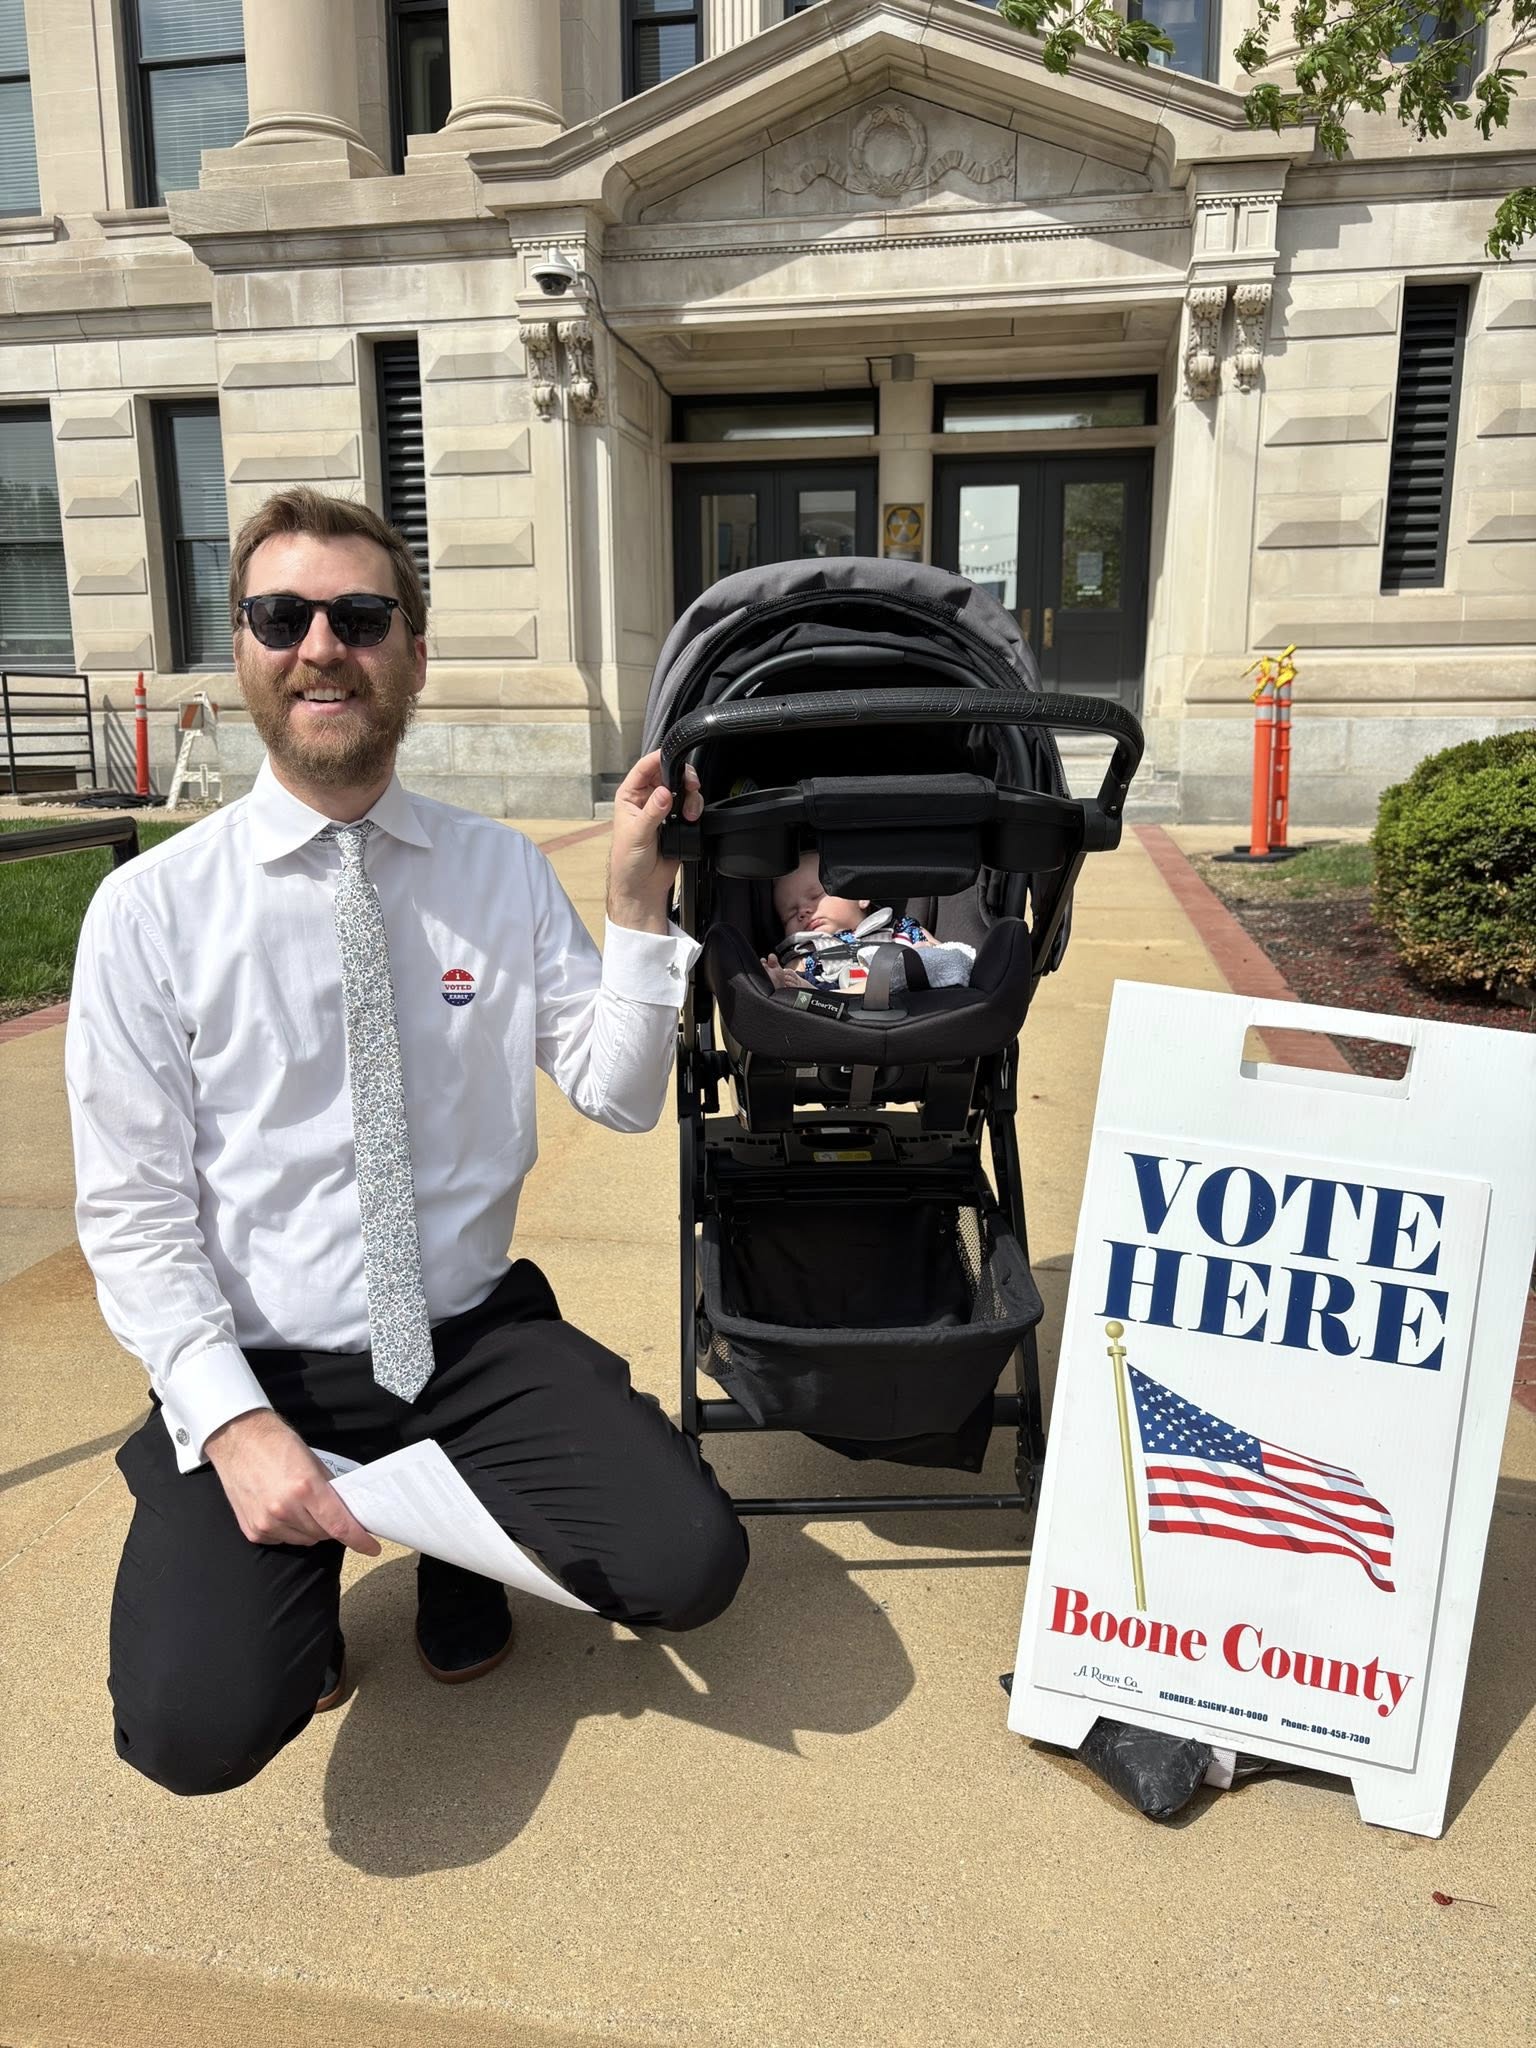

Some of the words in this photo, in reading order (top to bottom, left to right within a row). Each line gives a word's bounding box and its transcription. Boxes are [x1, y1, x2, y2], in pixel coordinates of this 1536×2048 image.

[811, 999, 839, 1012] ClearTex
[1124, 1151, 1445, 1276] VOTE
[1094, 1239, 1449, 1372] HERE
[1046, 1586, 1207, 1661] Boone
[1222, 1623, 1414, 1717] County
[1159, 1690, 1196, 1706] REORDER:
[1197, 1699, 1269, 1722] ASIGNV-A01-0000
[1281, 1718, 1309, 1732] Phone:
[1311, 1724, 1370, 1745] 800-458-7300
